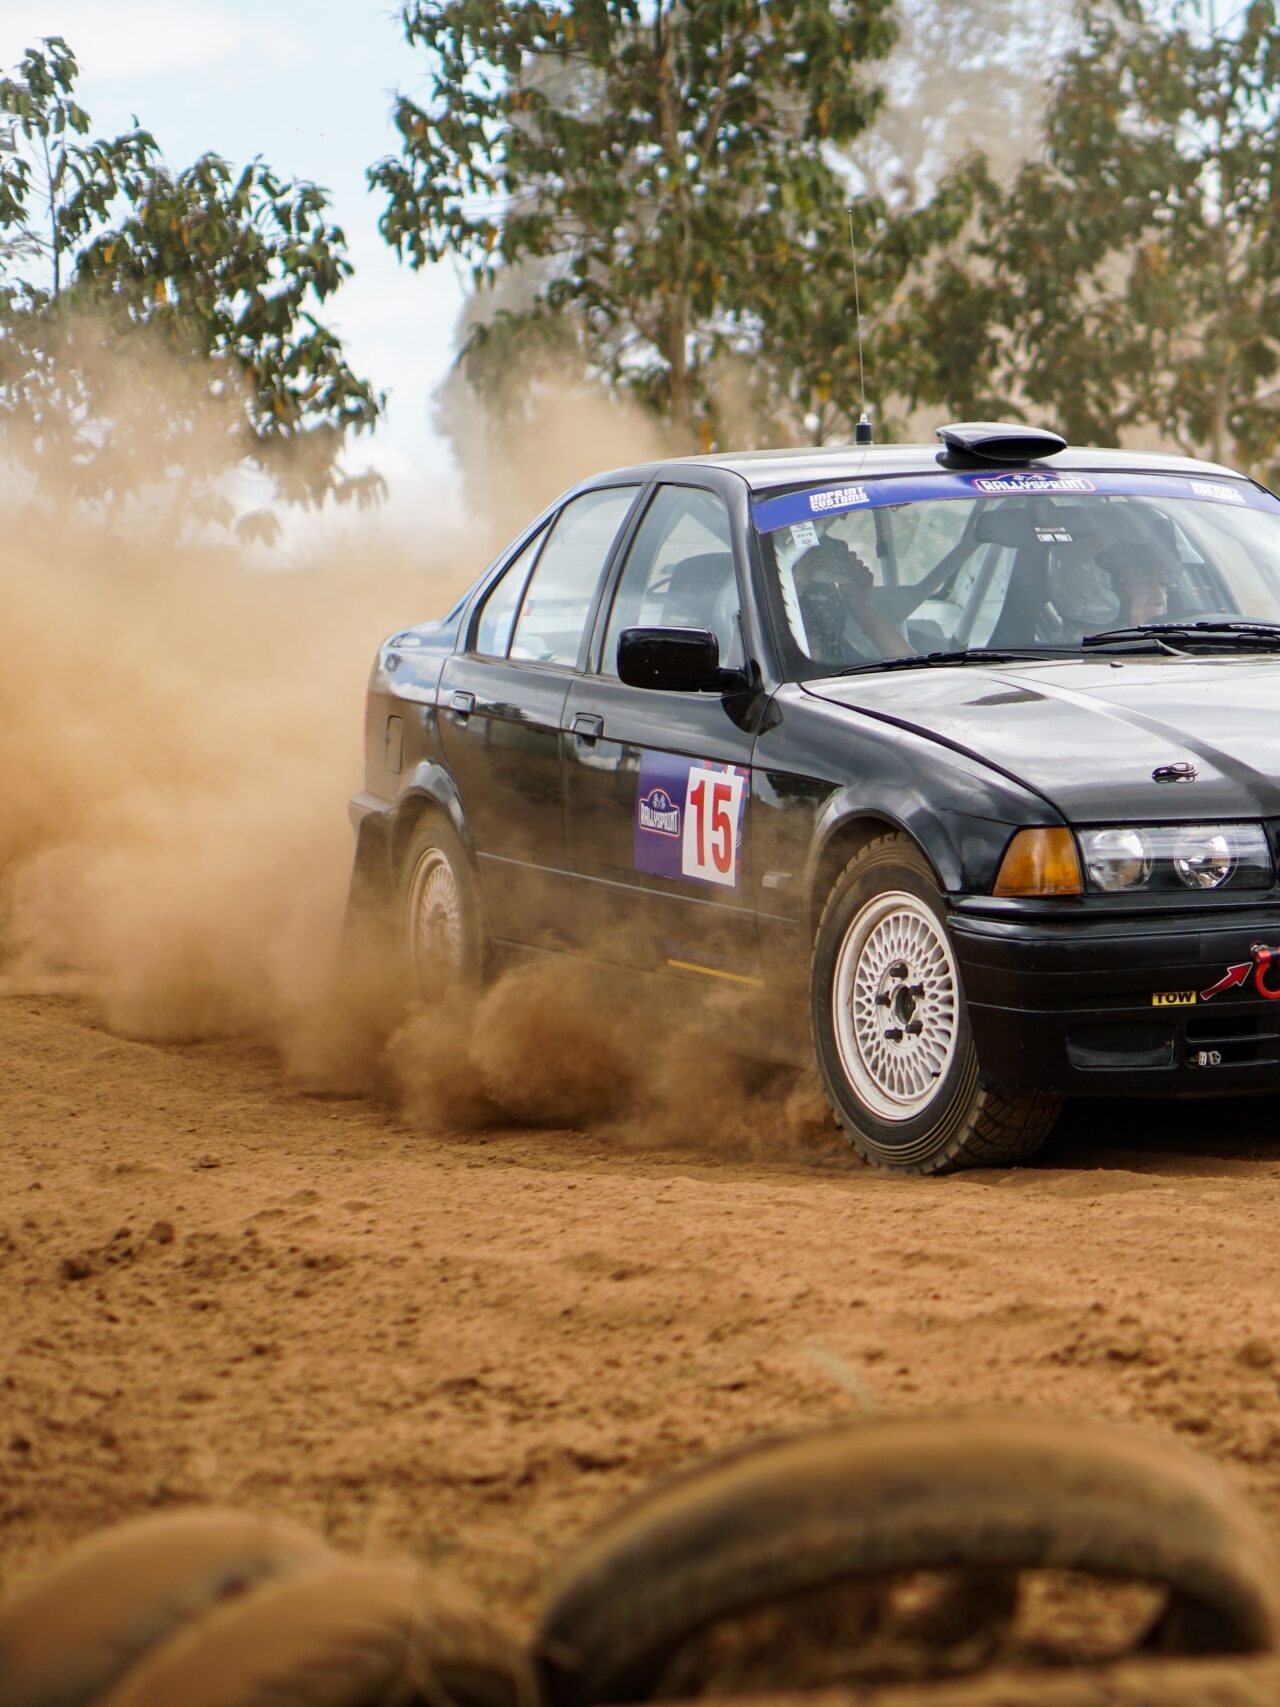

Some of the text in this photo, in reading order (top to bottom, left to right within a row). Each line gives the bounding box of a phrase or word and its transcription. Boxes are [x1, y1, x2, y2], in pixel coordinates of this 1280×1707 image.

[980, 479, 1086, 491] RALLYSPRINT
[809, 486, 864, 503] IMPRINT
[810, 493, 868, 509] CUSTOMS
[640, 802, 678, 833] RALLYSPRINT
[690, 779, 732, 874] 15
[1155, 992, 1192, 1004] TOW
